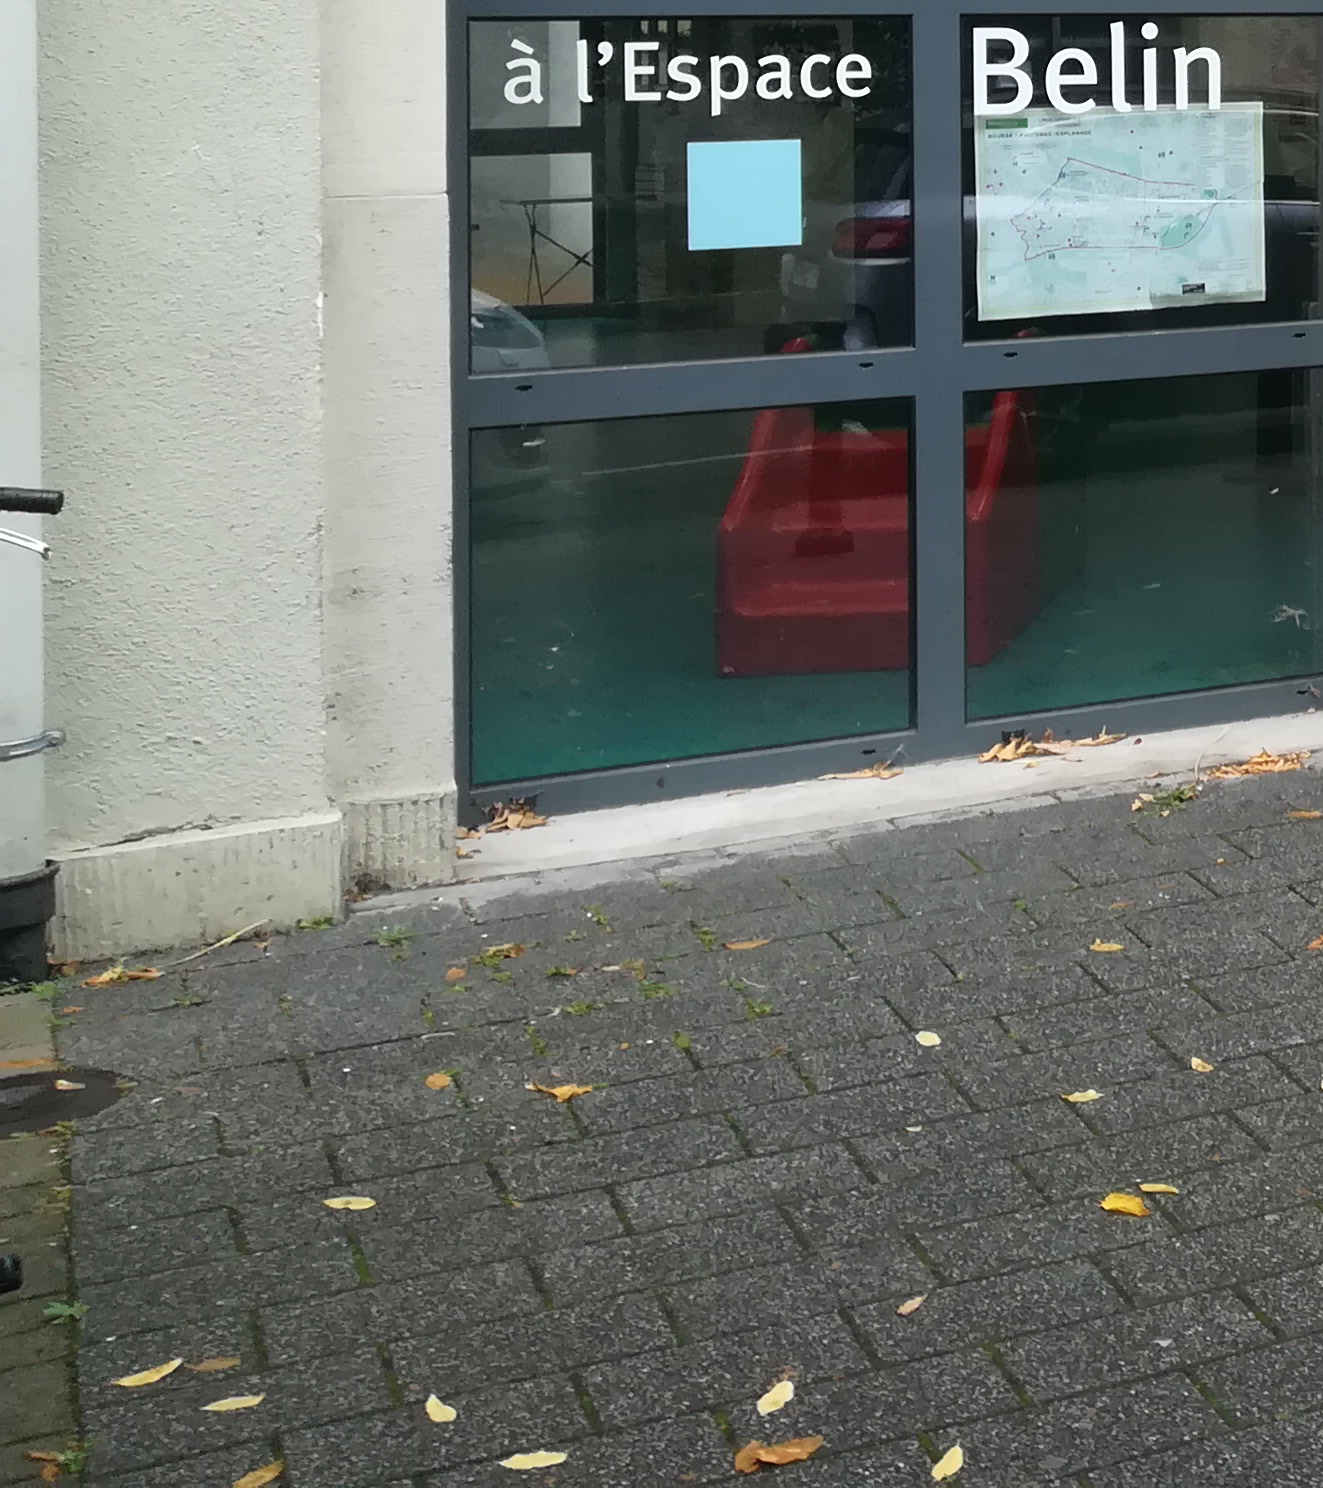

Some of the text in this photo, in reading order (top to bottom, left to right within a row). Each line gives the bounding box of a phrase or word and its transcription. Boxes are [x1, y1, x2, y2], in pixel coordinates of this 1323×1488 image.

[503, 21, 1224, 117] à l'Espace Belin
